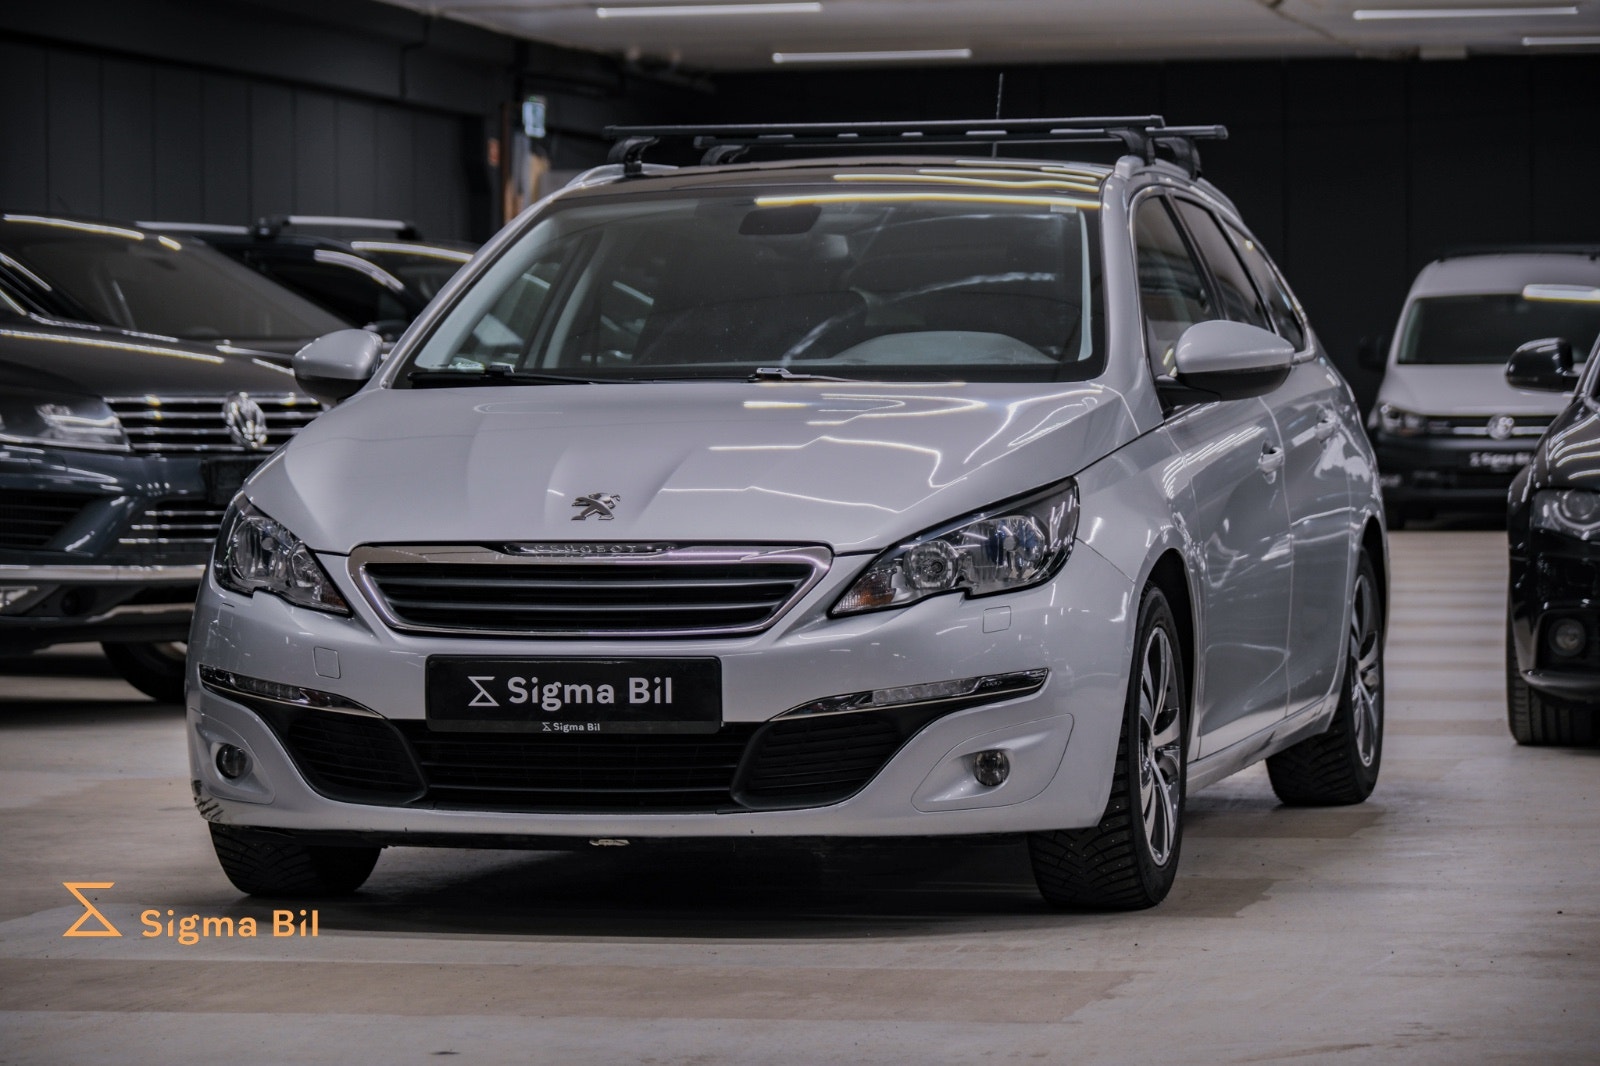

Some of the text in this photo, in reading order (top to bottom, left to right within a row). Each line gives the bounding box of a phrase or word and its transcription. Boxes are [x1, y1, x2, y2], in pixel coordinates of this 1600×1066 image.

[507, 676, 672, 712] Sigma Bil
[553, 722, 600, 733] Sigma Bil
